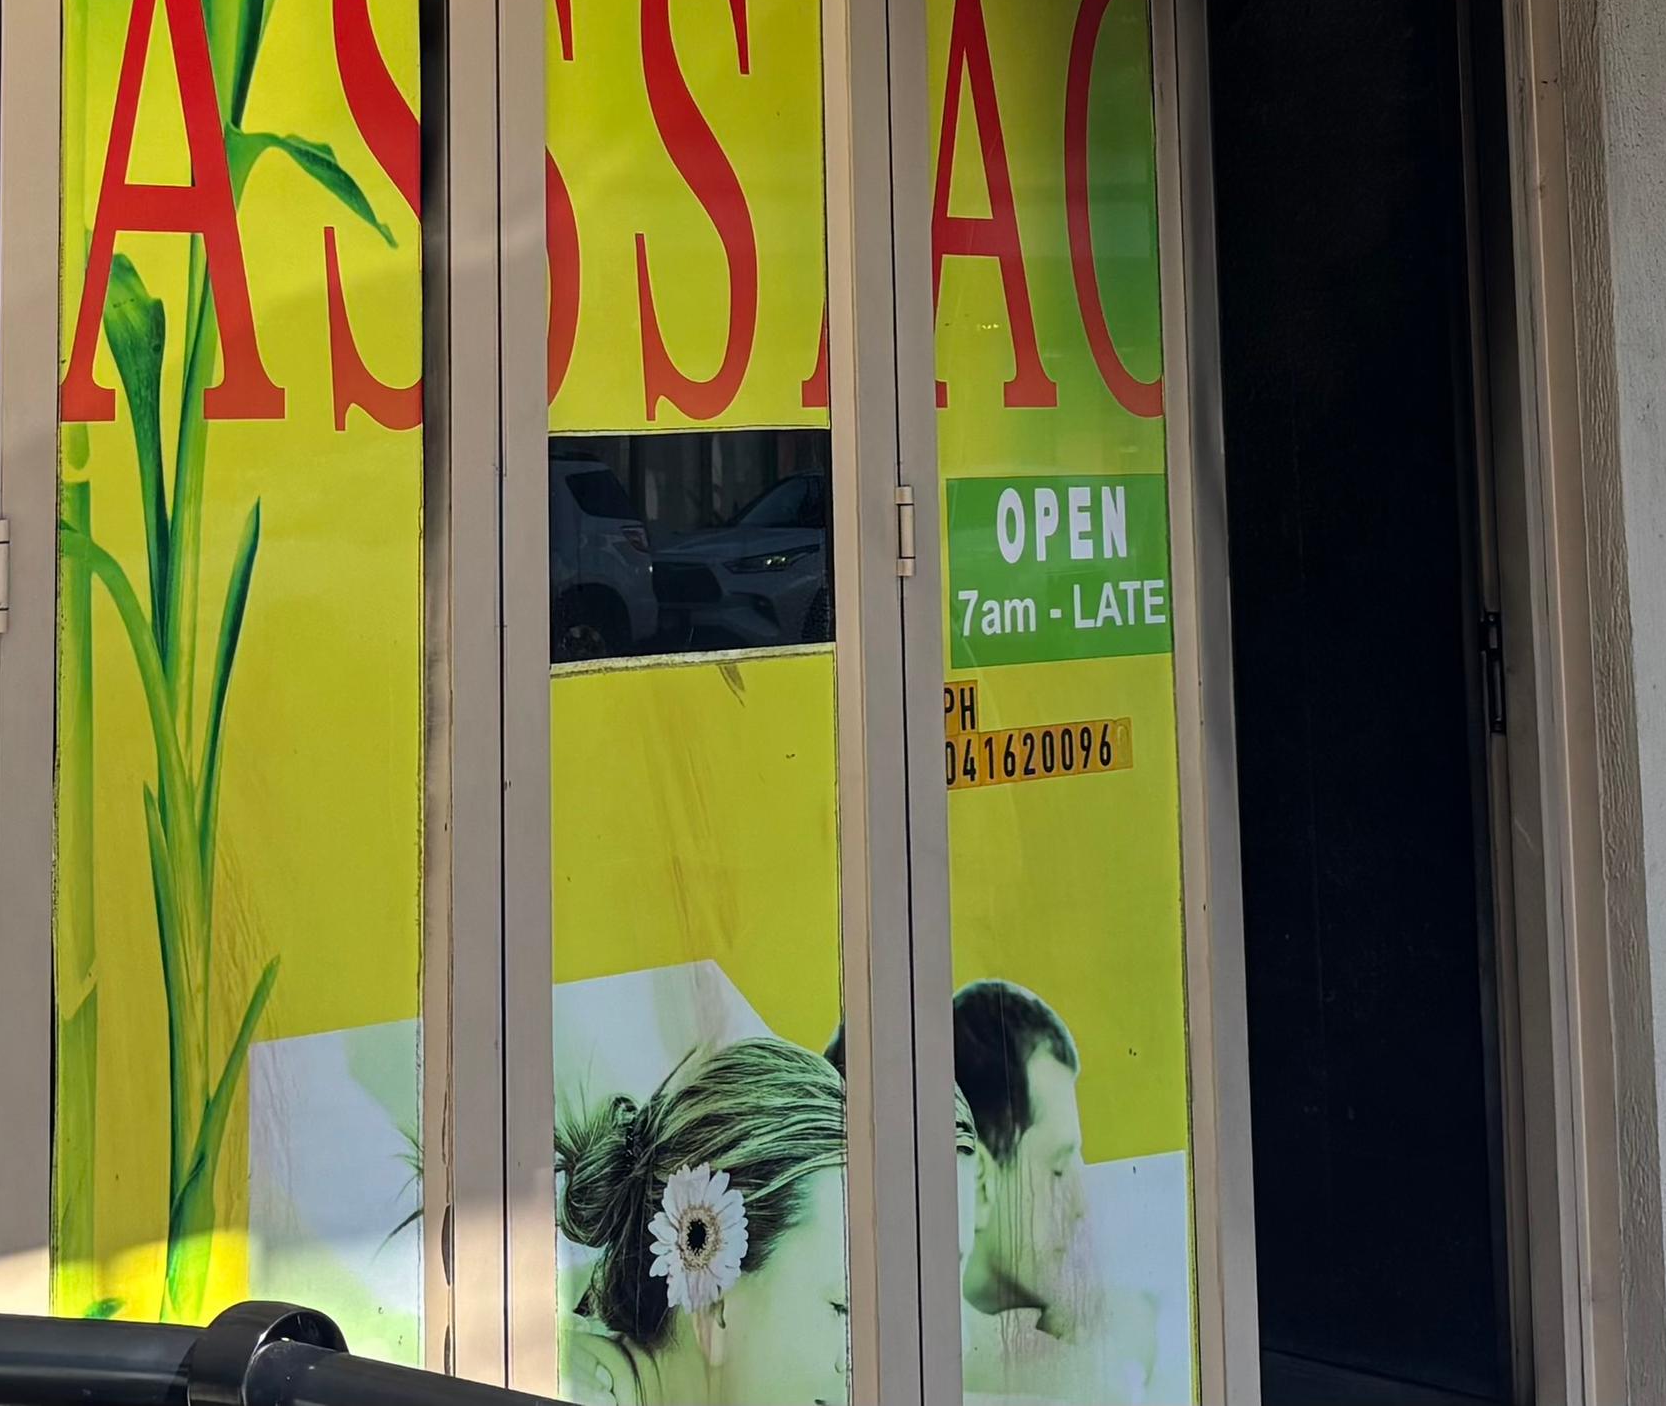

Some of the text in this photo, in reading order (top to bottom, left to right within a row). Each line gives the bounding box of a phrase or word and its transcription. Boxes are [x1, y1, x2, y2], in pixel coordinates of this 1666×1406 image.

[996, 485, 1128, 564] OPEN
[958, 589, 1037, 638] 7am
[1072, 579, 1167, 630] LATE
